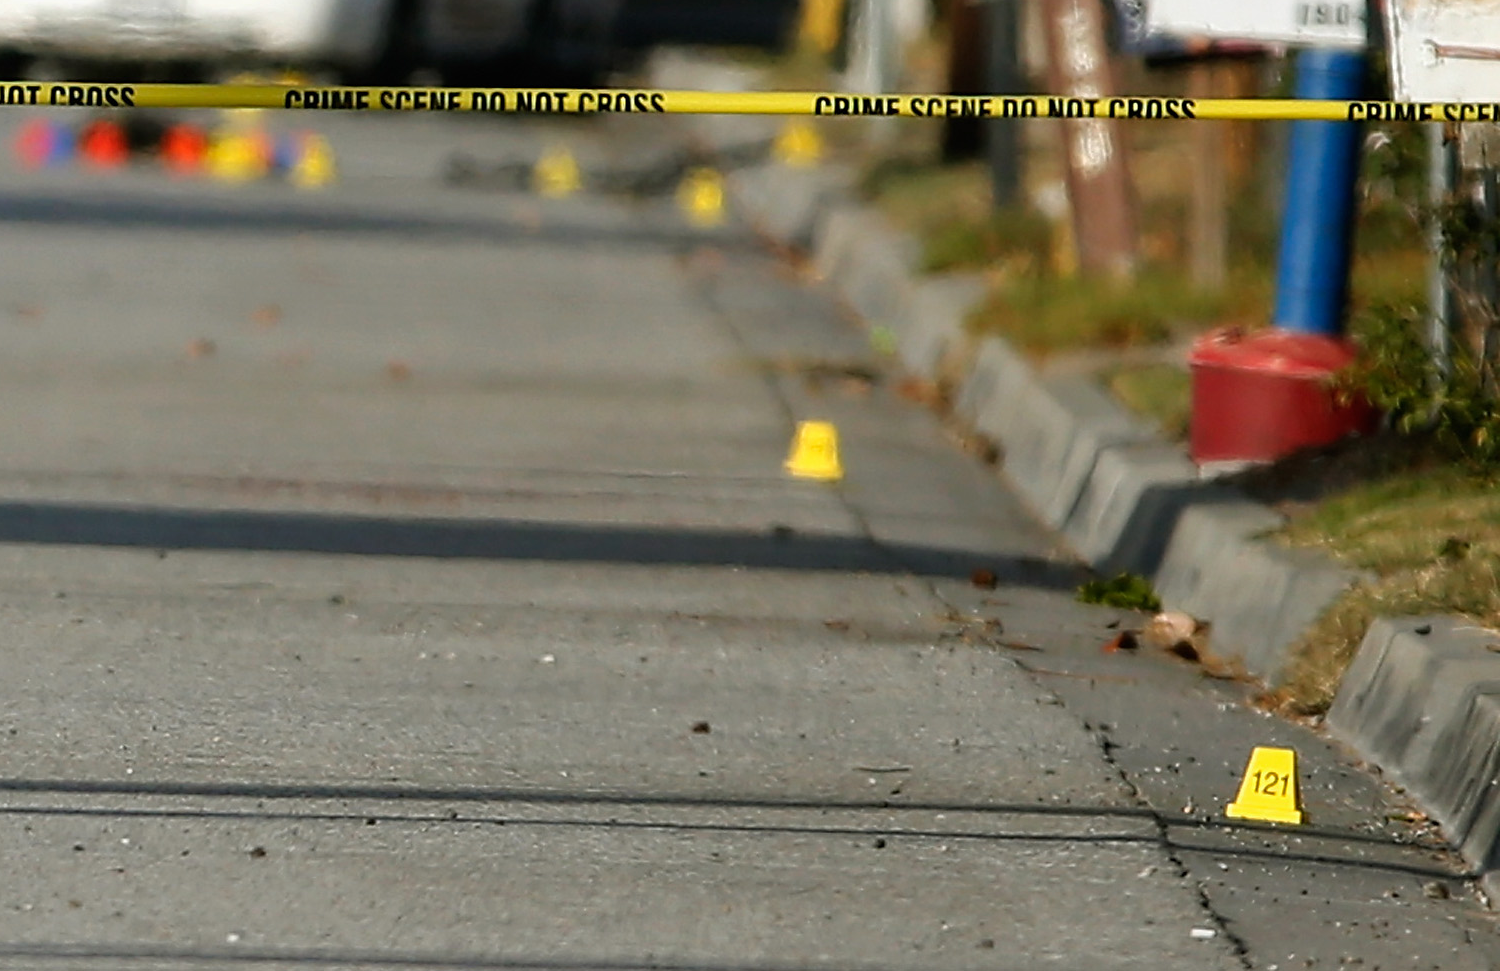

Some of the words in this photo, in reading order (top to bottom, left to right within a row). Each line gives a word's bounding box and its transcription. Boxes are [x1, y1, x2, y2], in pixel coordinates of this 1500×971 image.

[50, 86, 135, 107] CROSS
[284, 90, 370, 109] CRIME
[379, 91, 462, 111] SCENE
[471, 91, 506, 111] DO
[516, 92, 569, 112] NOT
[578, 93, 664, 113] CROSS
[815, 96, 900, 116] CRIME
[910, 97, 992, 117] SCENE
[1002, 98, 1037, 118] DO
[1048, 99, 1098, 119] NOT
[1108, 99, 1195, 120] CROSS
[1348, 103, 1433, 121] CRIME
[1443, 103, 1500, 121] SCE
[1252, 770, 1289, 798] 121
